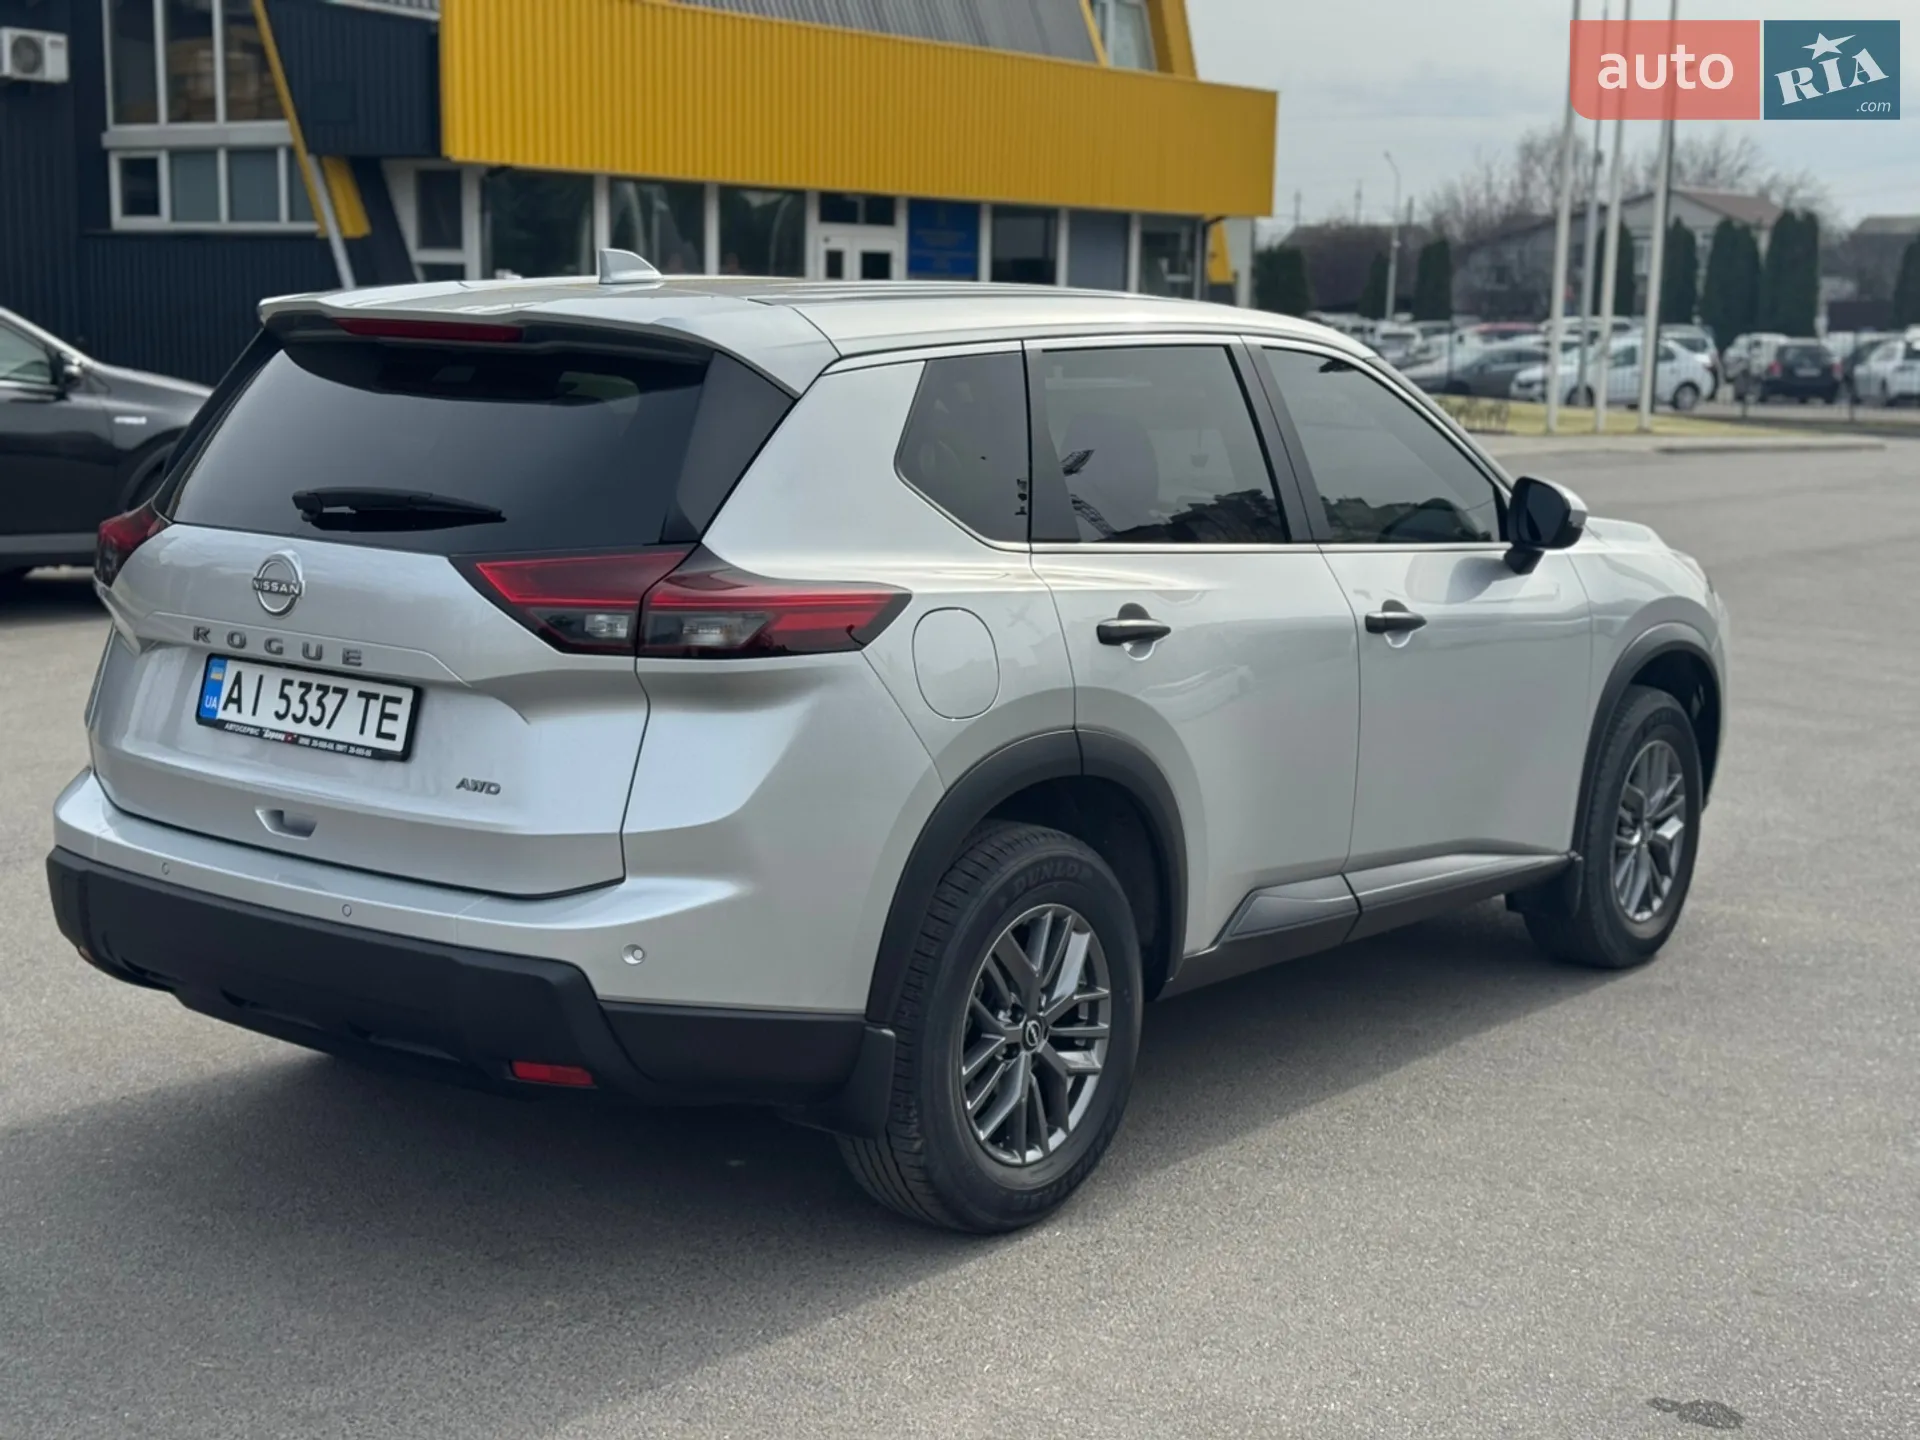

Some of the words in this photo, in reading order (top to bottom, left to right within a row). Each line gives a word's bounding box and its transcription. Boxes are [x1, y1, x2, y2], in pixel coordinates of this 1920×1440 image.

[253, 579, 300, 594] NISSAN
[193, 626, 362, 667] ROGUE
[204, 695, 217, 709] UA
[222, 670, 264, 717] AI
[274, 678, 348, 730] 5337
[357, 690, 402, 741] TE
[455, 777, 501, 796] AWD
